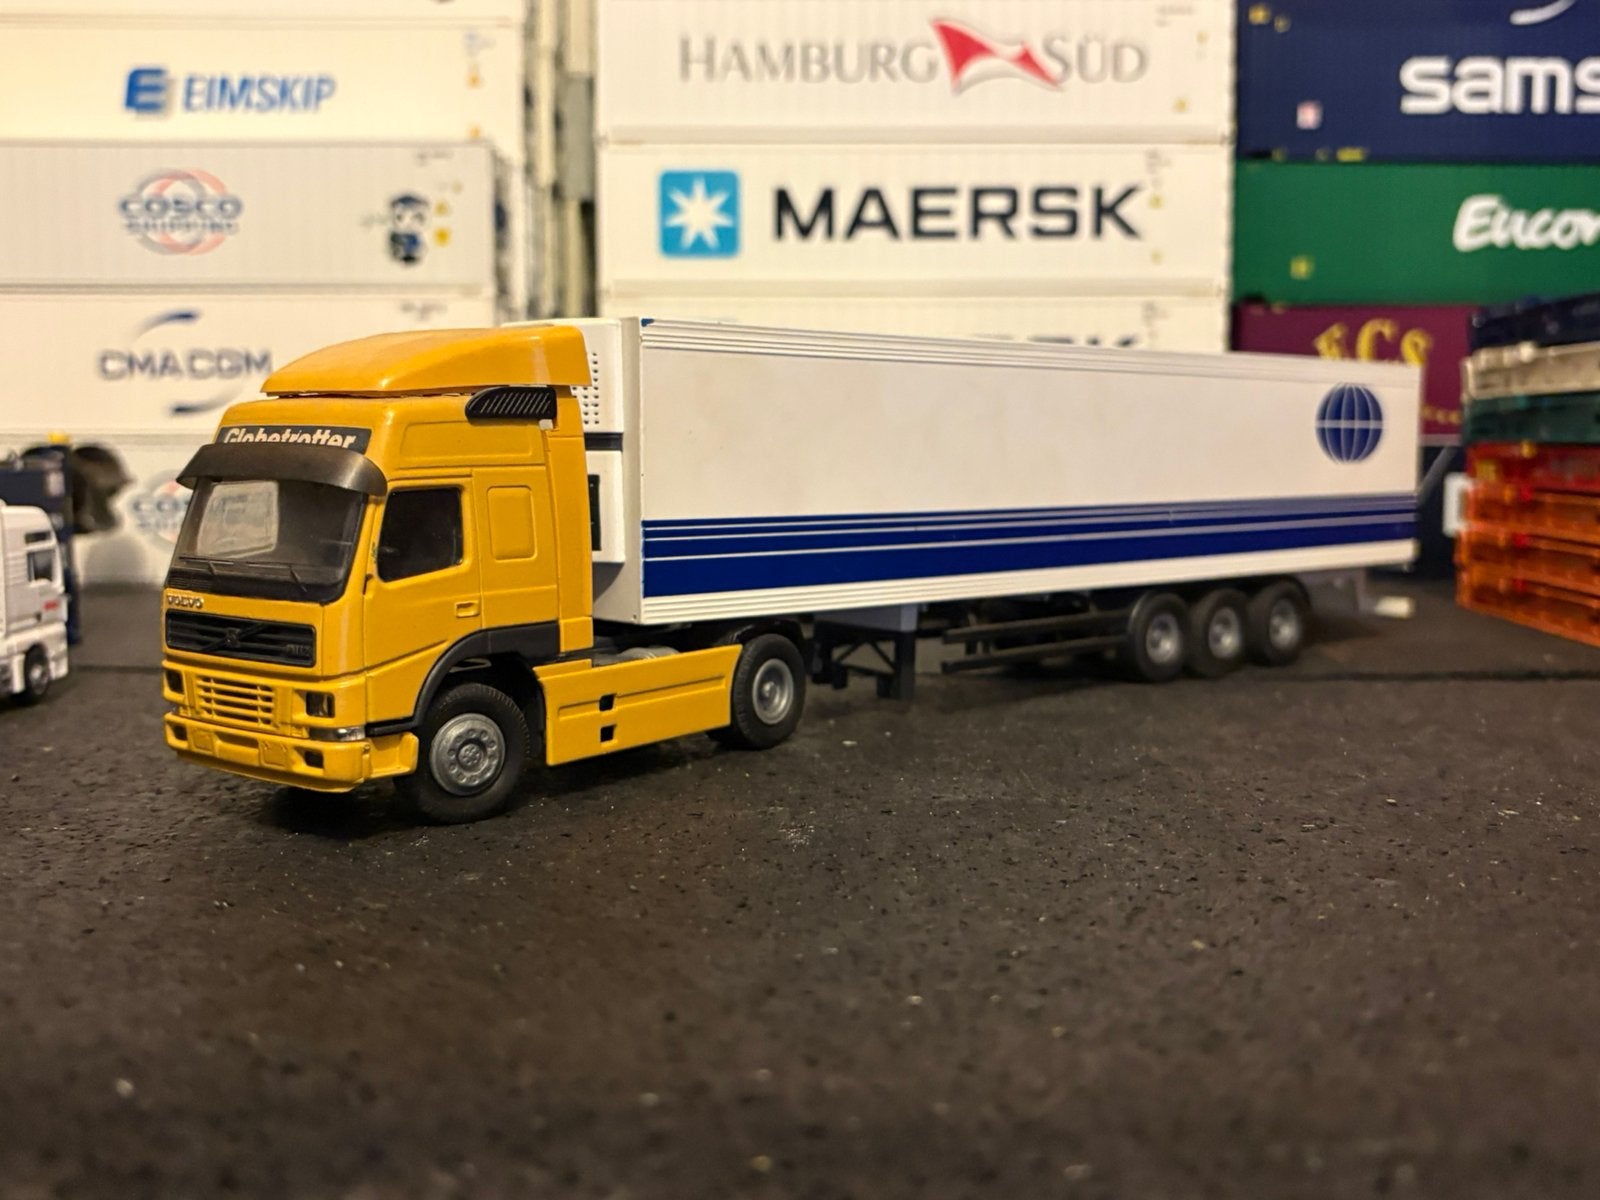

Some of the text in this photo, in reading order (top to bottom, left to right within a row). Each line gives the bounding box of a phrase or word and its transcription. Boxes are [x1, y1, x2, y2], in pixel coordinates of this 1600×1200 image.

[678, 31, 1151, 85] HAMBURG SÜD
[182, 73, 337, 114] EIMSKIP
[118, 195, 243, 219] COSCO
[773, 186, 1143, 241] MAERSK
[99, 349, 272, 381] CMA CGM
[166, 593, 205, 609] VOLVO
